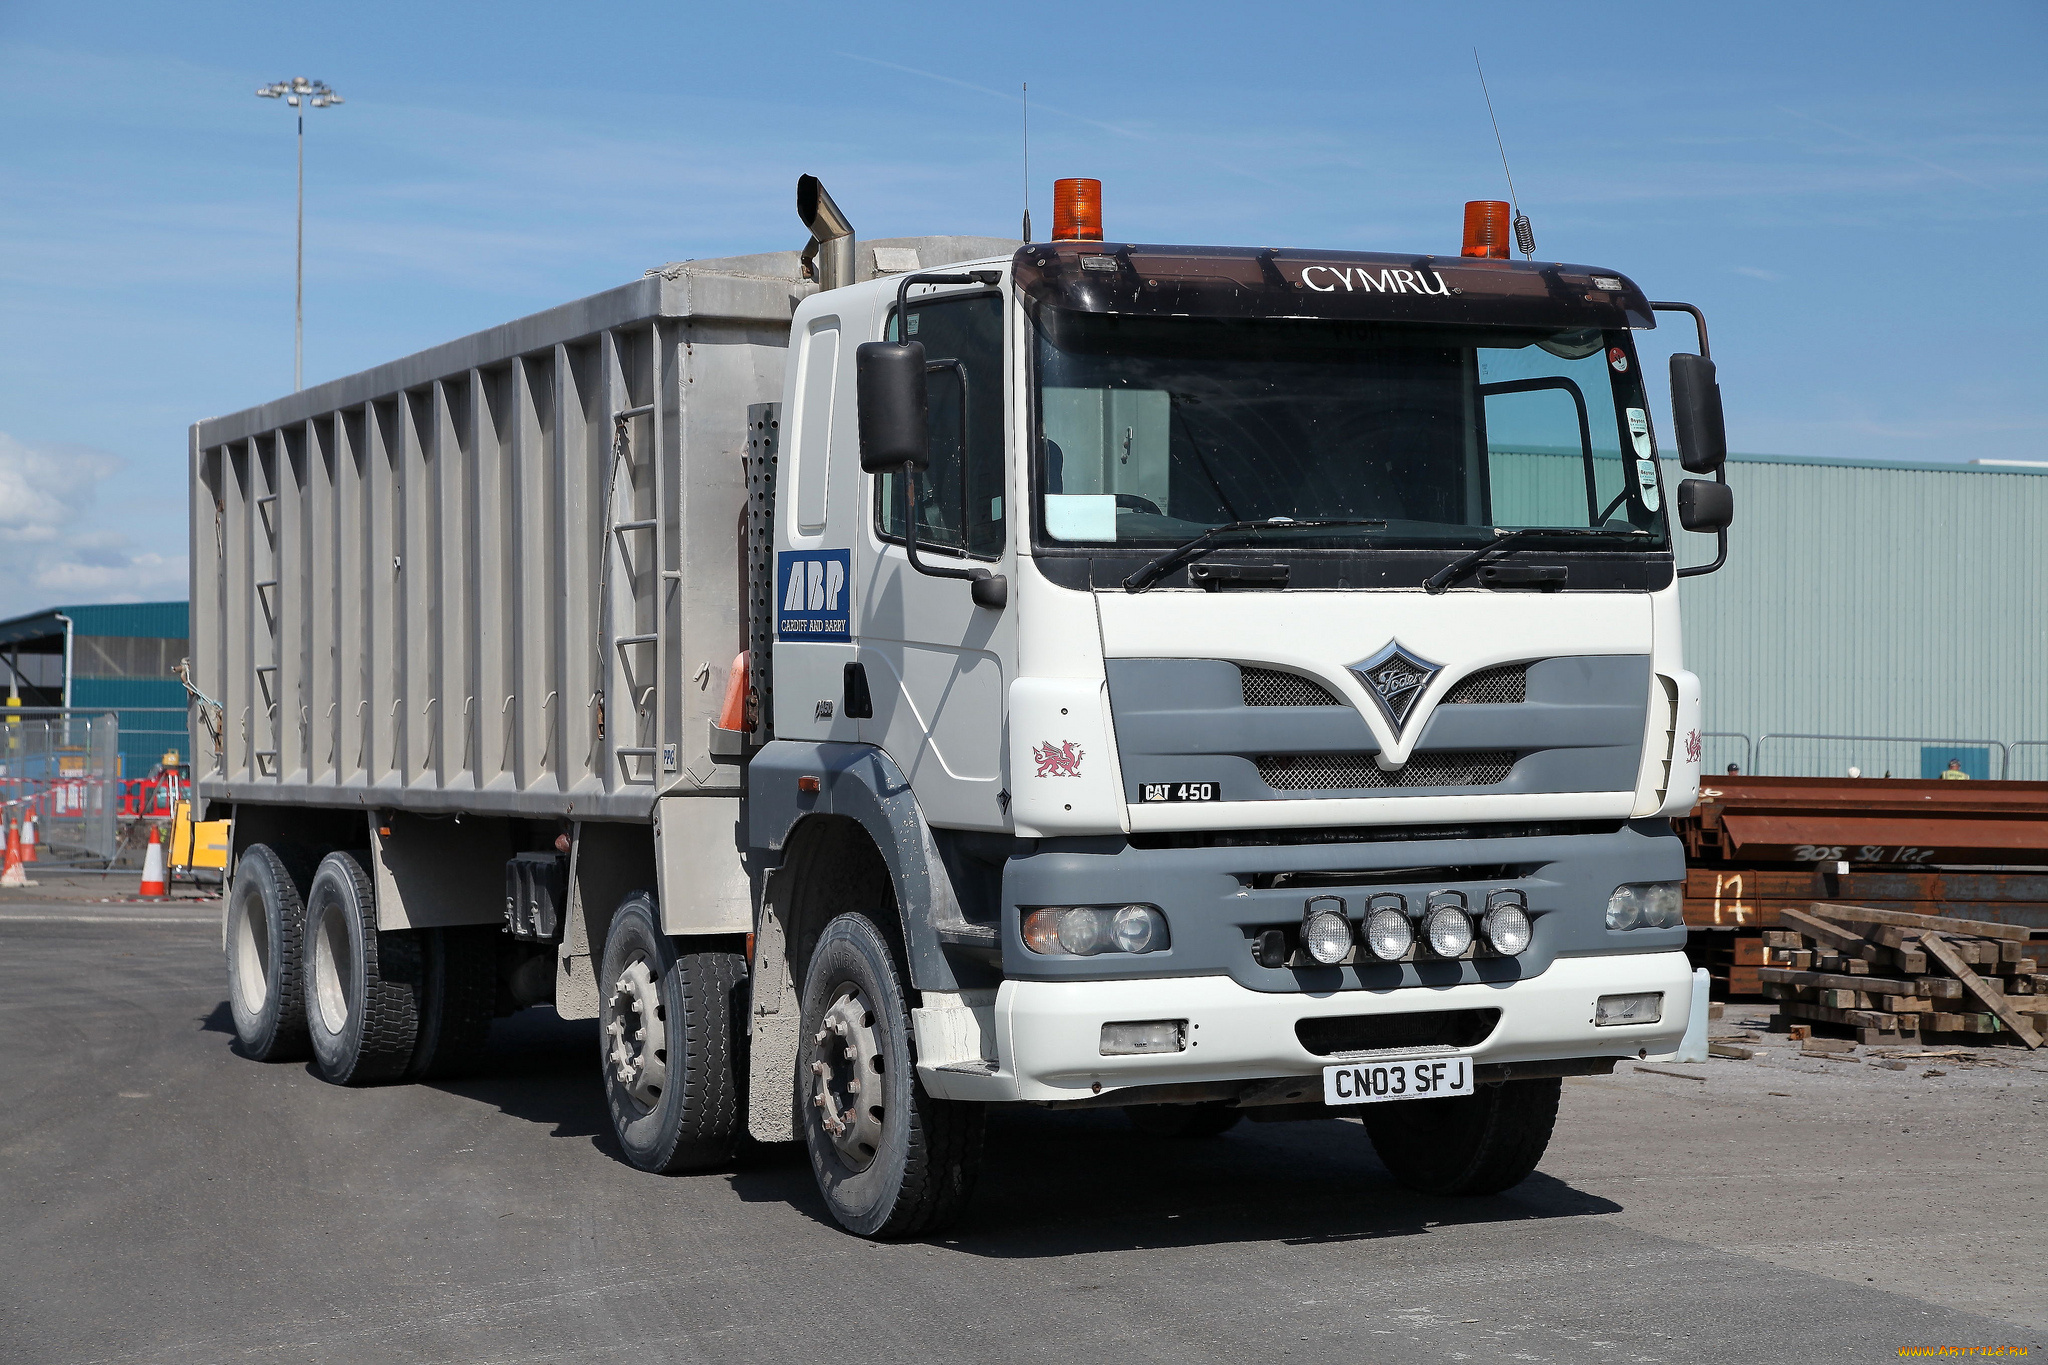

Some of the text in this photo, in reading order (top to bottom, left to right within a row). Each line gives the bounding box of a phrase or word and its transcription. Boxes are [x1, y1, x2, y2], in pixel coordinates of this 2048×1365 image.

[1301, 265, 1452, 296] CYMRU
[783, 560, 844, 611] ABP
[781, 619, 847, 632] CARDIFF AND BARRY
[1378, 669, 1423, 695] Foden
[1145, 783, 1212, 801] CAT 450
[1793, 844, 1848, 862] 305
[1714, 873, 1754, 925] 17
[1335, 1061, 1464, 1098] CN03 SFJ
